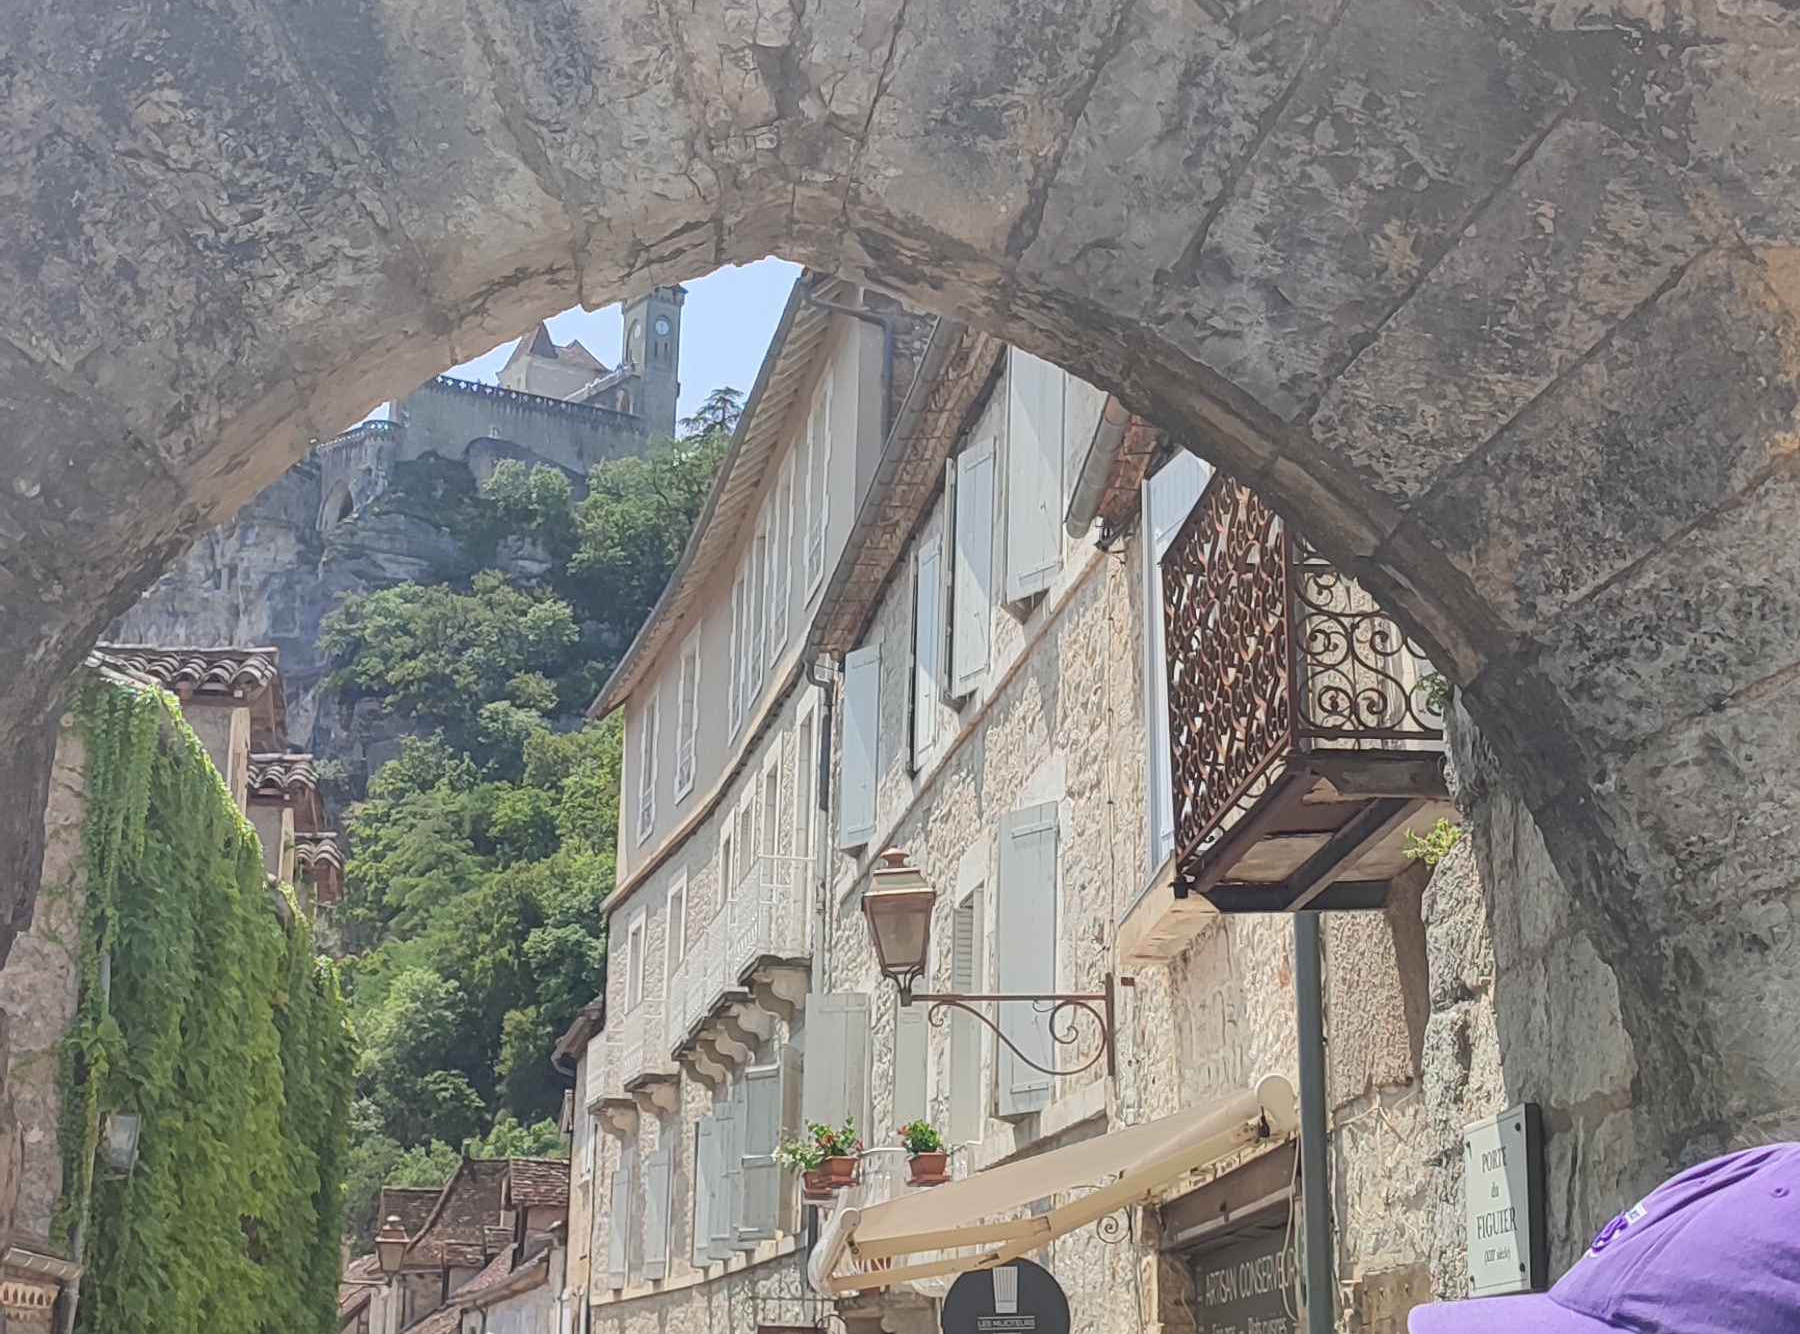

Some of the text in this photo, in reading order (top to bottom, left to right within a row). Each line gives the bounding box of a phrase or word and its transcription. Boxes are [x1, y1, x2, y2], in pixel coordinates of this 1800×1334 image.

[1482, 1146, 1507, 1173] PORTE
[1477, 1207, 1518, 1240] FIGUIER
[1206, 1266, 1237, 1306] ARTISAN
[978, 1320, 992, 1328] LES
